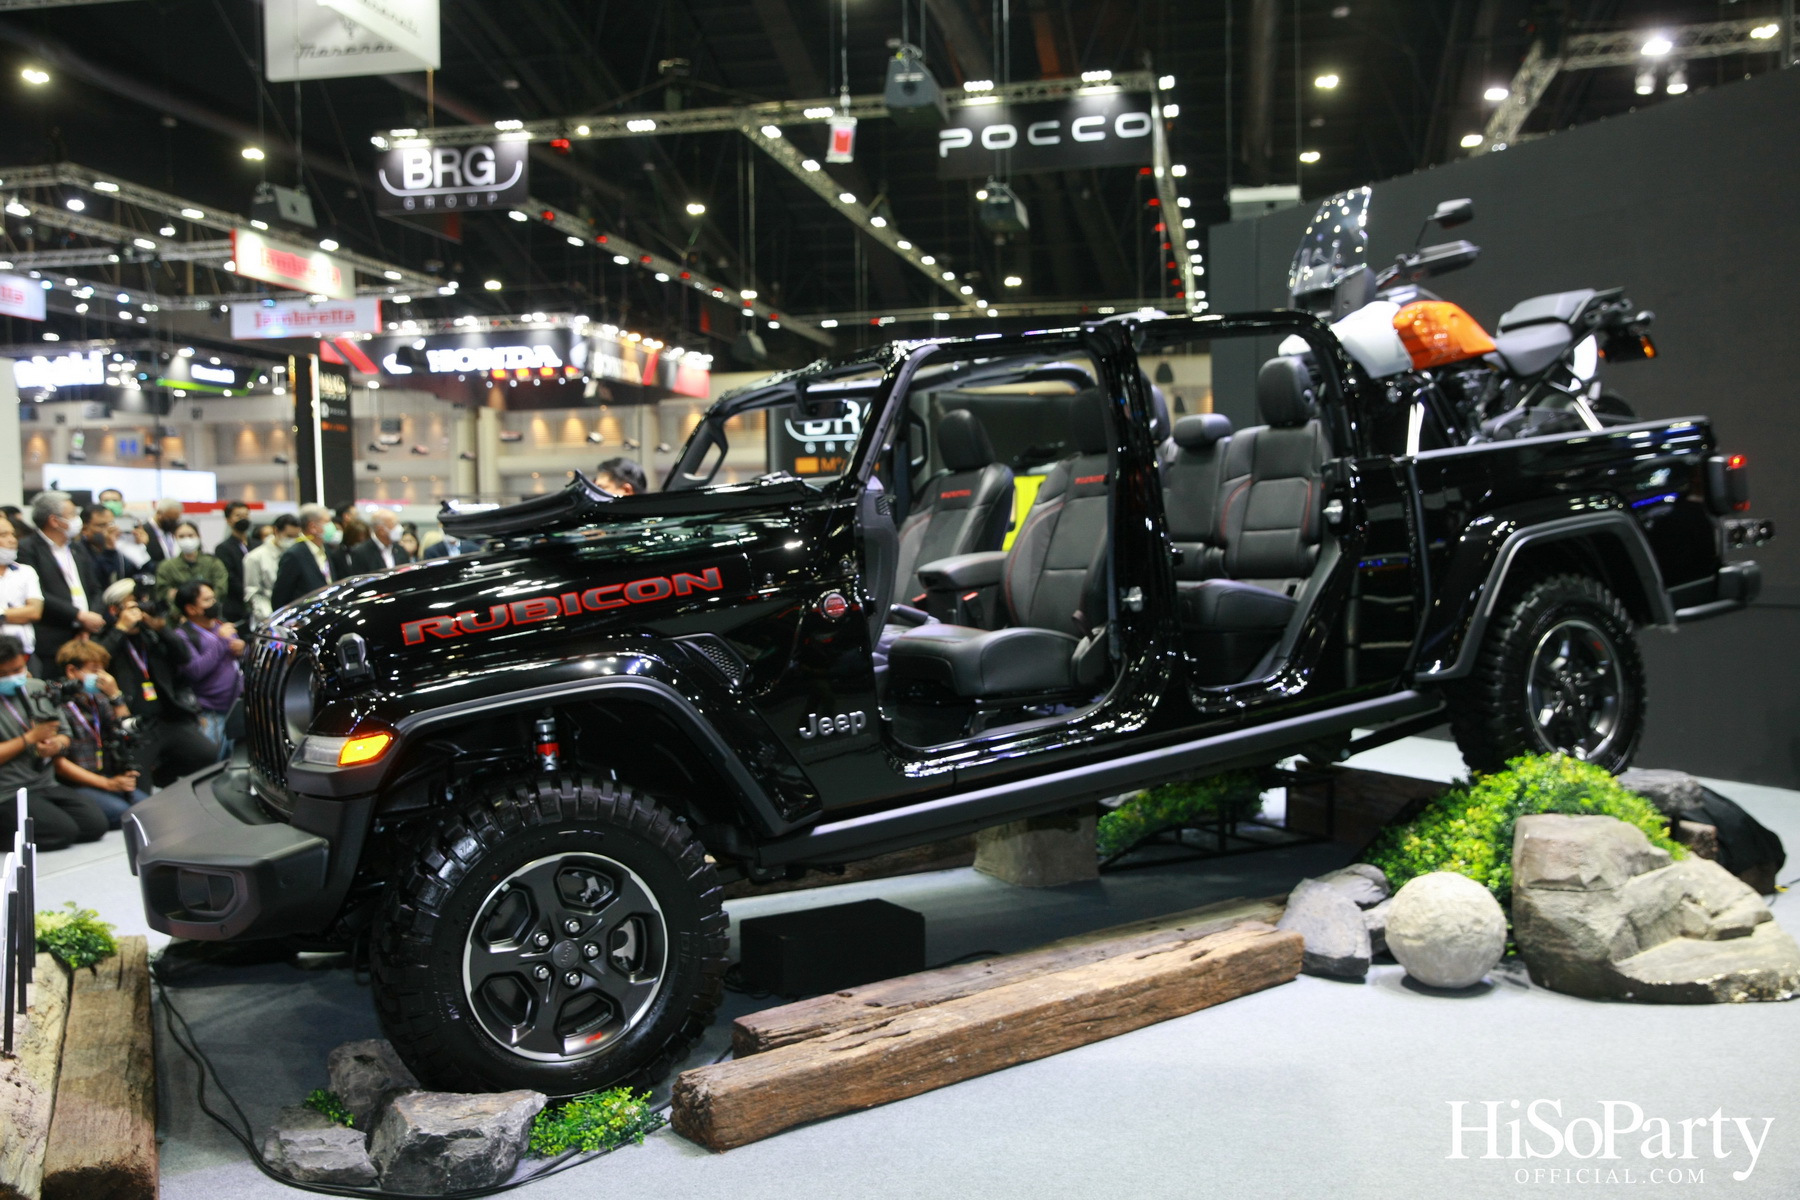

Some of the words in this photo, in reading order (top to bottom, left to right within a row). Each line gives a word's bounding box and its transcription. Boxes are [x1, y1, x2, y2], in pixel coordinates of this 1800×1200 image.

[939, 111, 1151, 157] POCCO
[402, 145, 496, 190] BRG
[426, 345, 563, 373] HONDA
[401, 567, 723, 645] RUBICON
[798, 709, 867, 740] Jeep
